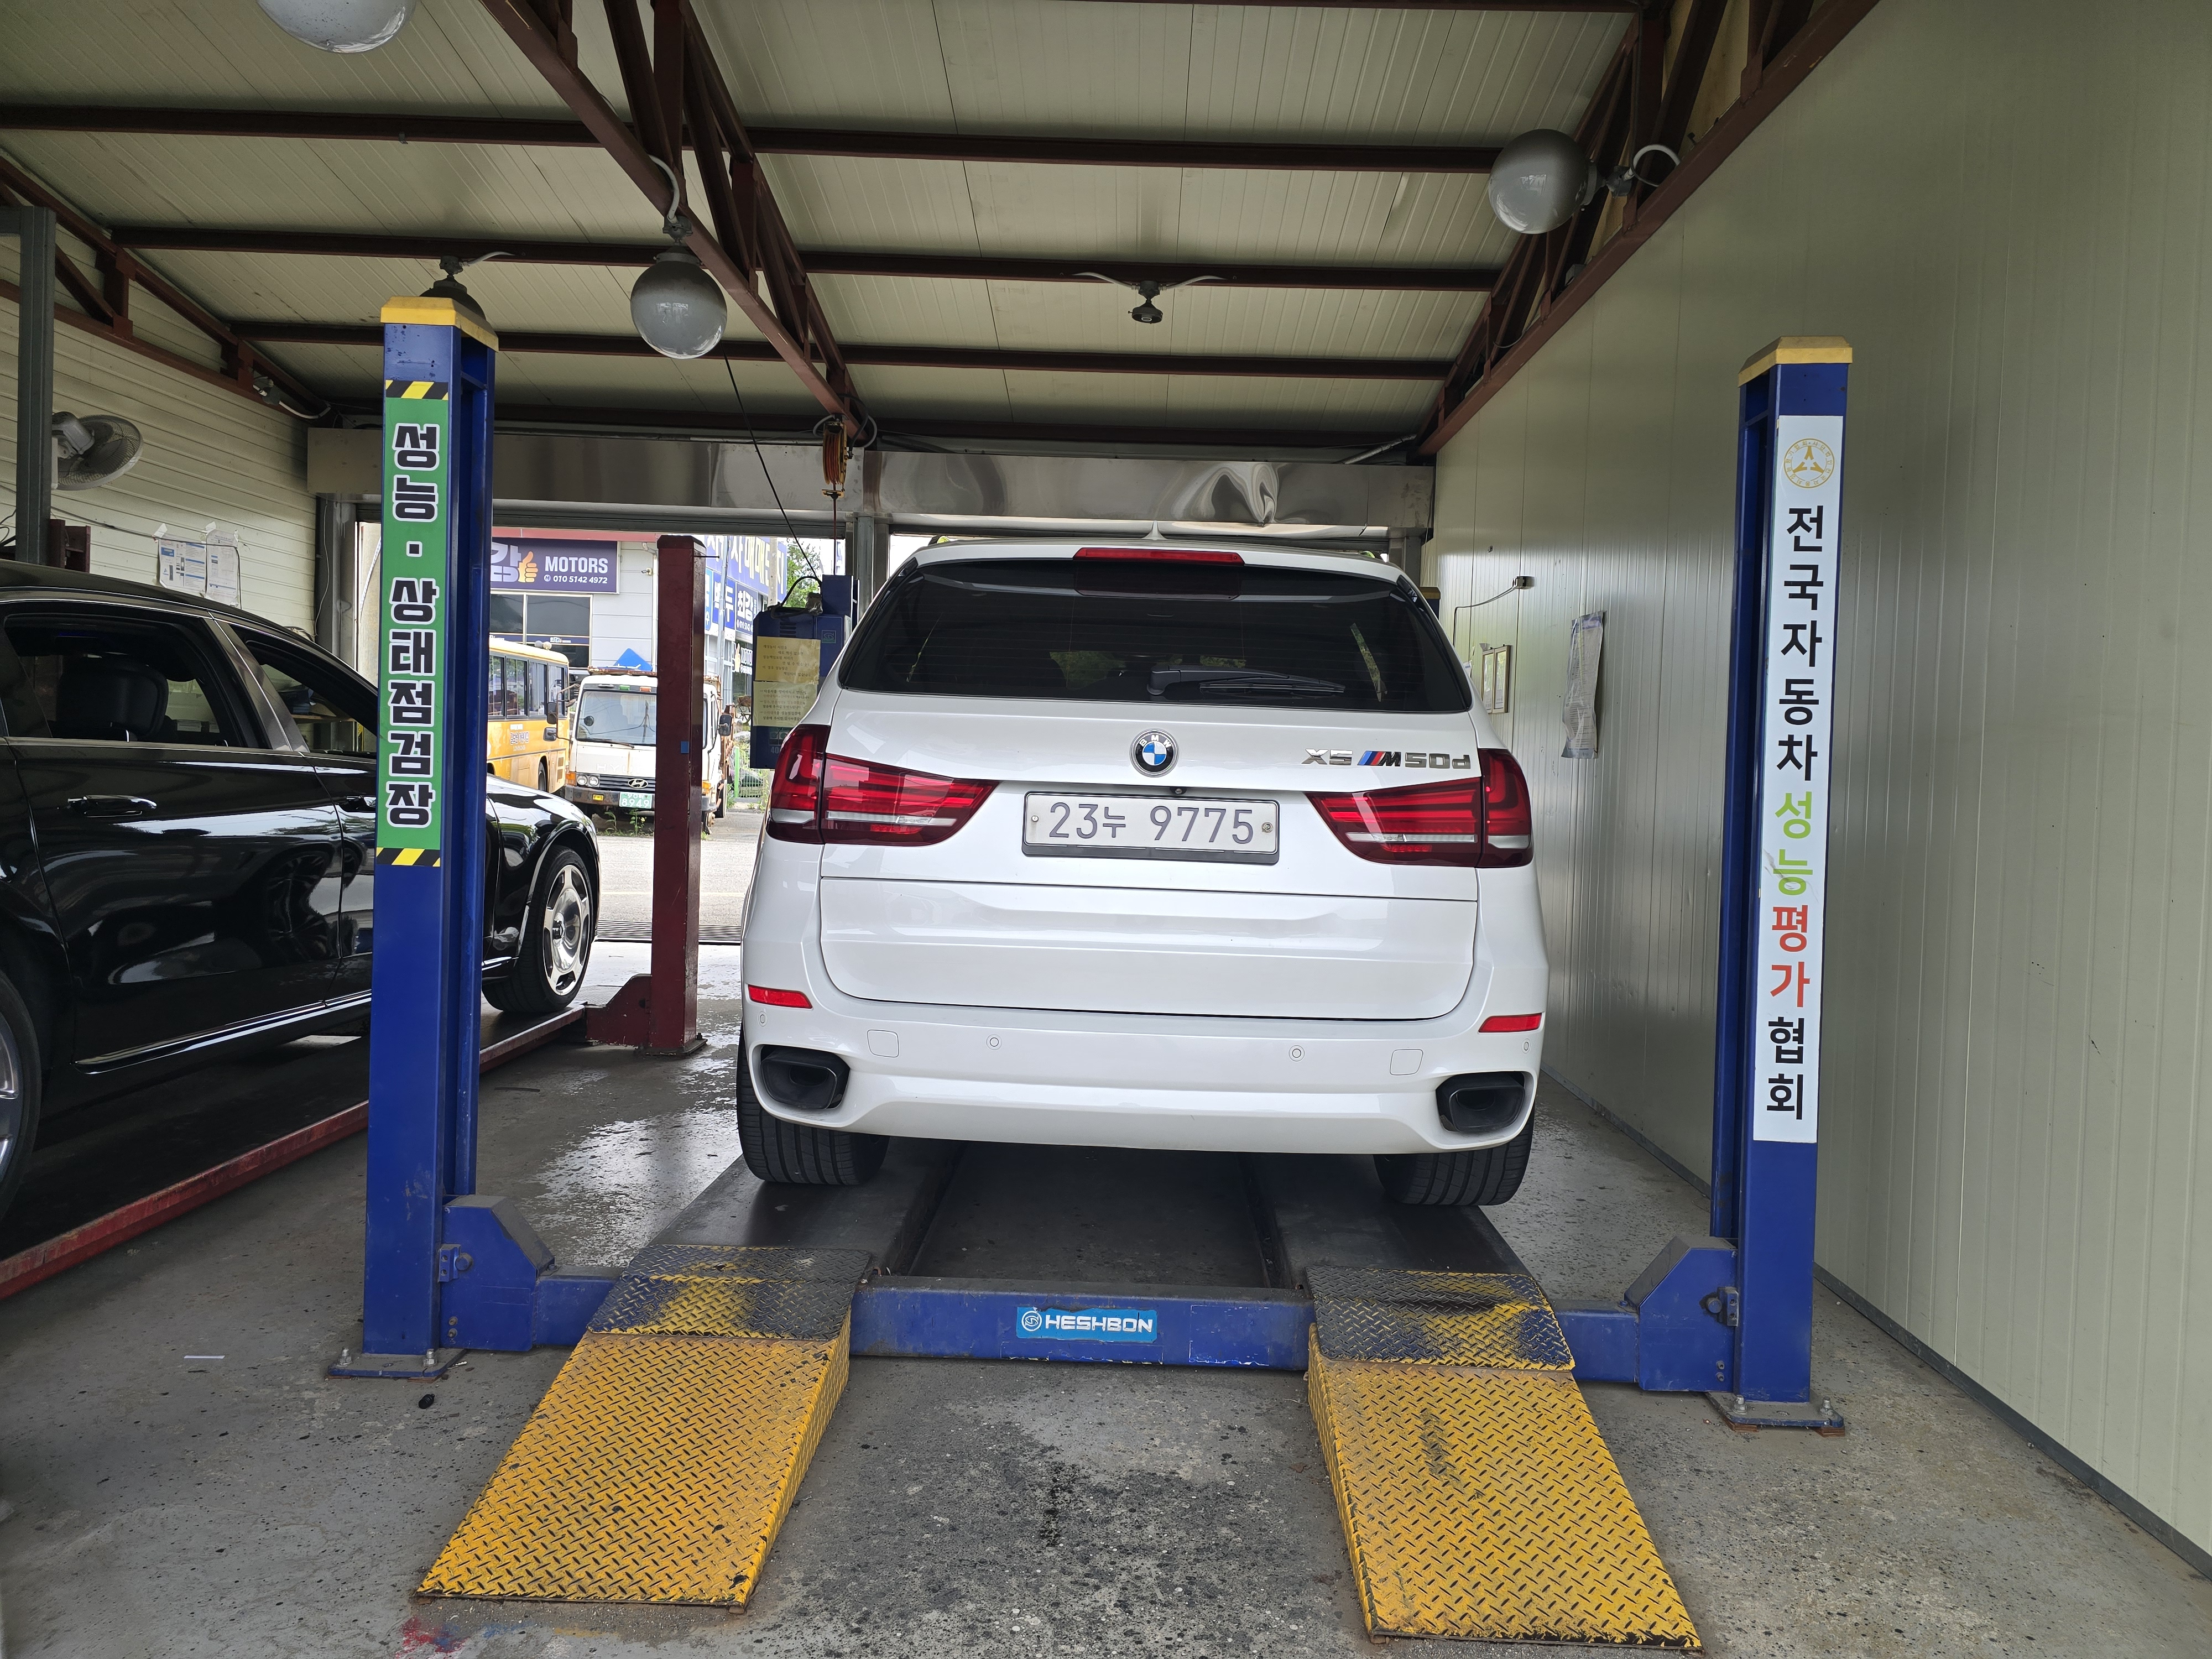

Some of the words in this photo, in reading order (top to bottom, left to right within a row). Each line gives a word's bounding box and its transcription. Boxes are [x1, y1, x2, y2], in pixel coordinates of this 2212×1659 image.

[545, 556, 608, 574] MOTORS
[737, 590, 753, 622] 최강
[1139, 734, 1172, 748] BMW
[1301, 748, 1353, 766] X5
[622, 798, 650, 807] 8949
[1049, 802, 1126, 839] 23누
[1150, 805, 1254, 844] 9775
[1045, 1314, 1153, 1333] HESHBON
